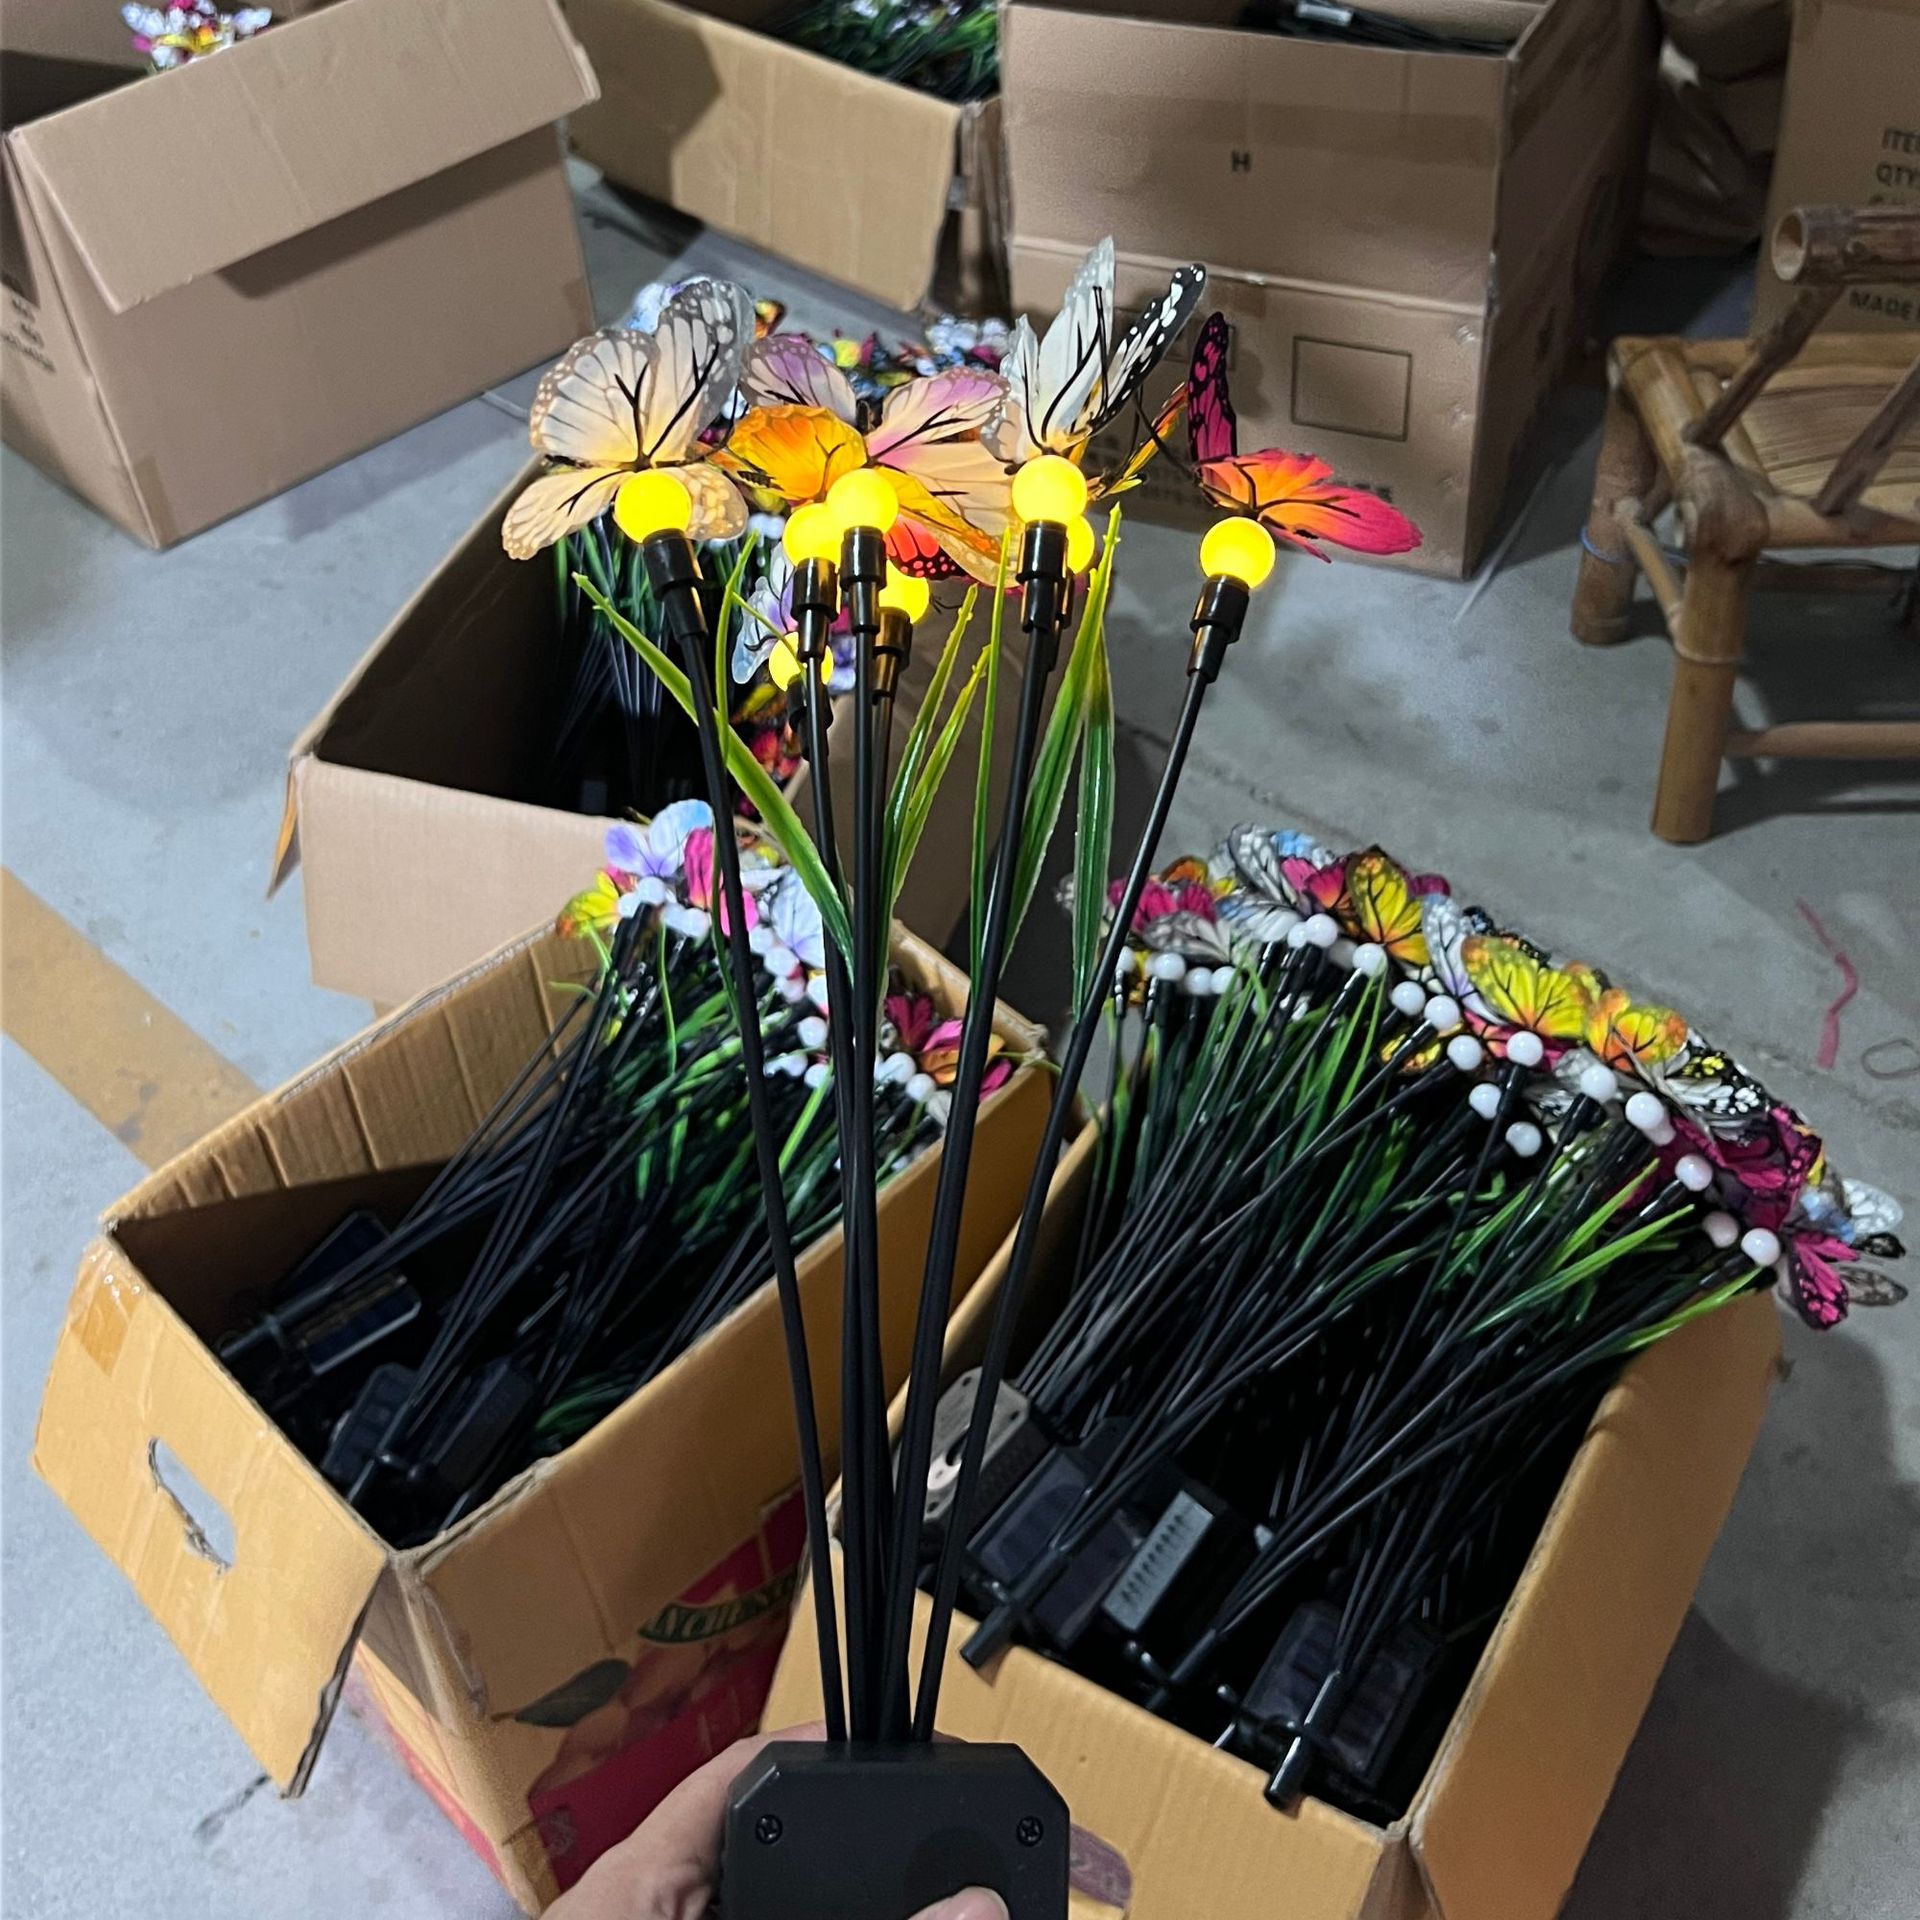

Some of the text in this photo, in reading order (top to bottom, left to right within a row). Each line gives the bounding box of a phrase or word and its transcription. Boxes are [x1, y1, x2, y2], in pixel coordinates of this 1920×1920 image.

[1882, 127, 1920, 154] ITE
[1231, 151, 1251, 172] H
[1849, 291, 1912, 320] MADE
